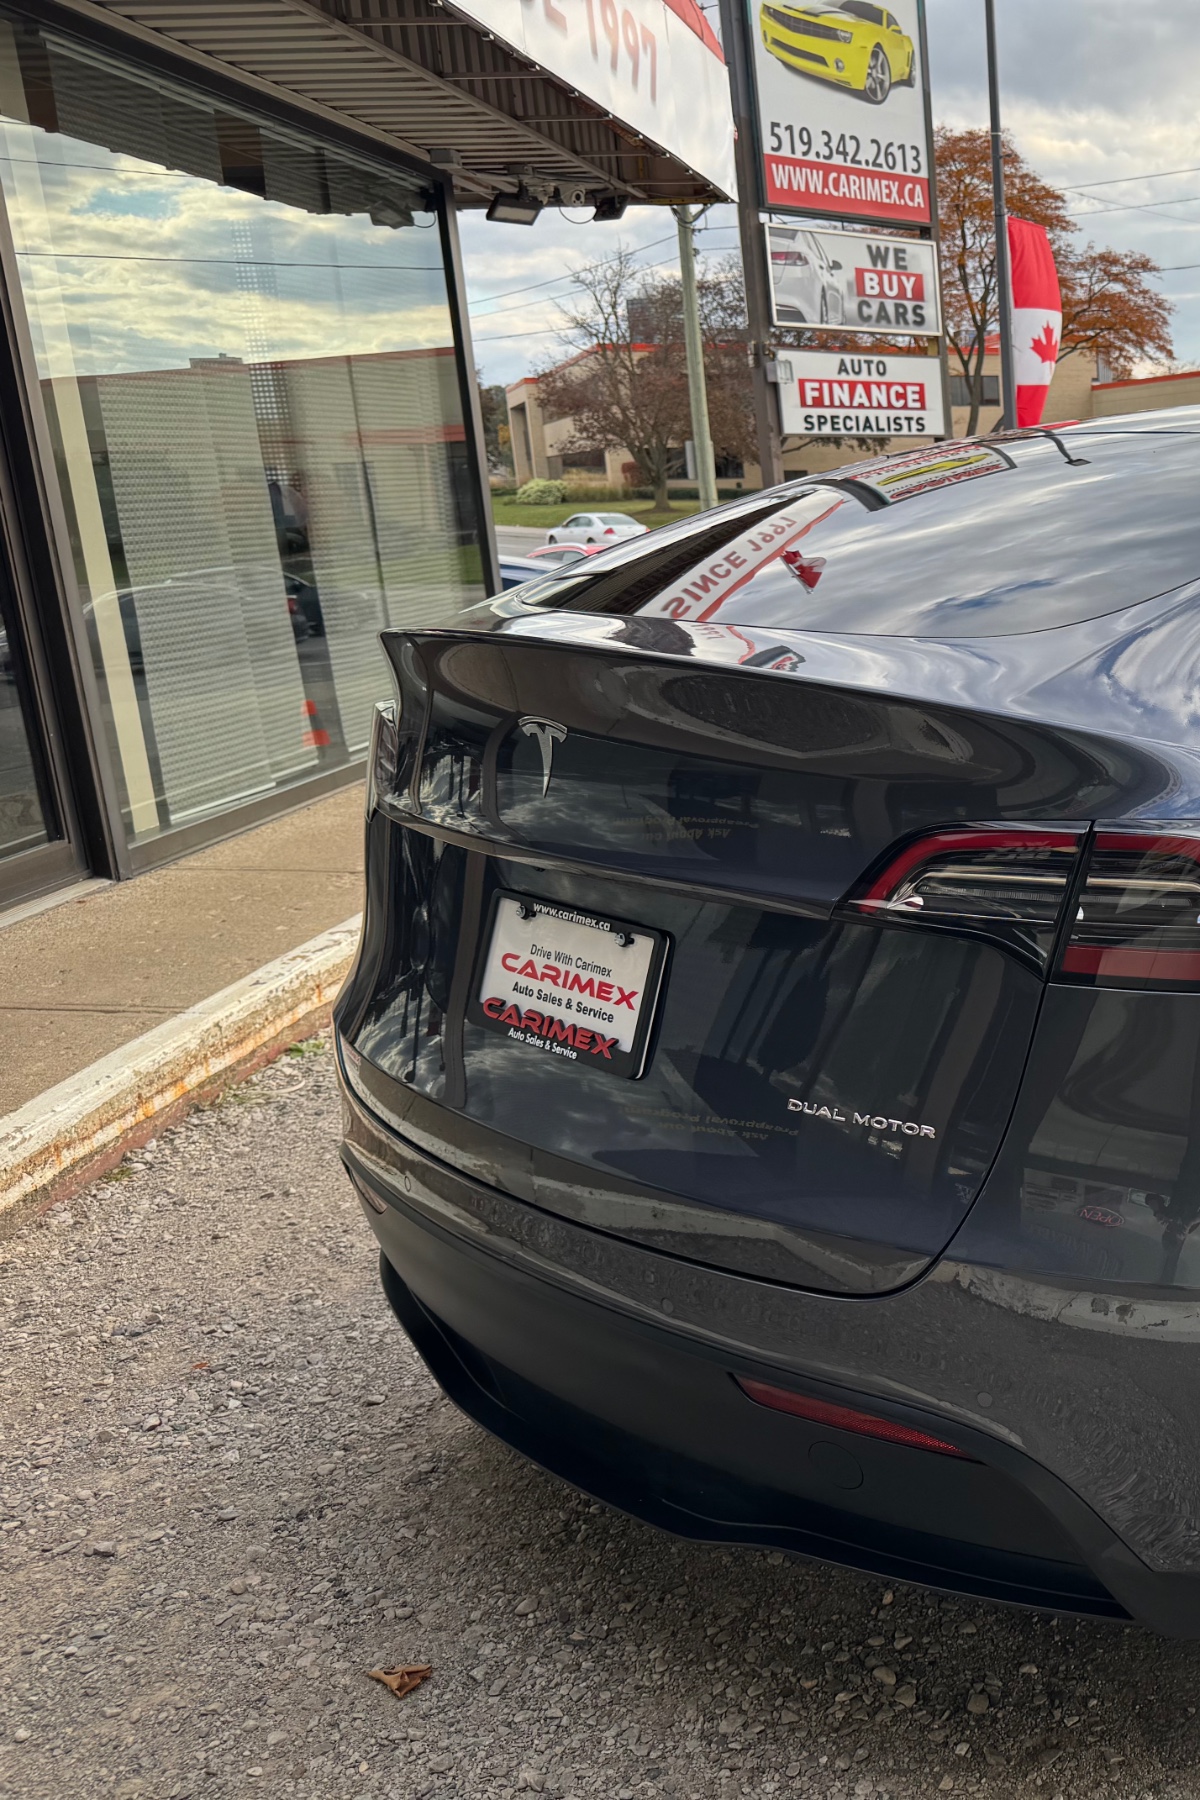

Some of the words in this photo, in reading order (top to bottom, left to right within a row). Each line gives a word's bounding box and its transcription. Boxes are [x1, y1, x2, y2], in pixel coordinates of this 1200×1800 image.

[771, 121, 922, 174] 519.342.2613
[771, 163, 924, 208] WWW.CARIMEX.CA
[867, 244, 908, 271] WE
[863, 273, 918, 298] BUY
[857, 300, 926, 326] CARS
[837, 358, 887, 376] AUTO
[804, 382, 922, 409] FINANCE
[803, 415, 926, 433] SPECIALISTS
[533, 903, 611, 931] www.carimex.ca
[530, 944, 552, 960] Drive
[554, 950, 573, 967] With
[575, 957, 612, 978] Carimex
[501, 952, 639, 1011] CARIMEX
[512, 981, 534, 998] Auto
[536, 988, 563, 1009] Sales
[565, 997, 574, 1011] &
[575, 1001, 614, 1024] Service
[482, 997, 617, 1060] CARIMEX
[508, 1027, 525, 1041] Auto
[525, 1033, 544, 1049] Sales
[544, 1039, 552, 1052] &
[552, 1042, 578, 1060] Service
[787, 1098, 846, 1122] DUAL
[852, 1112, 936, 1139] MOTOR
